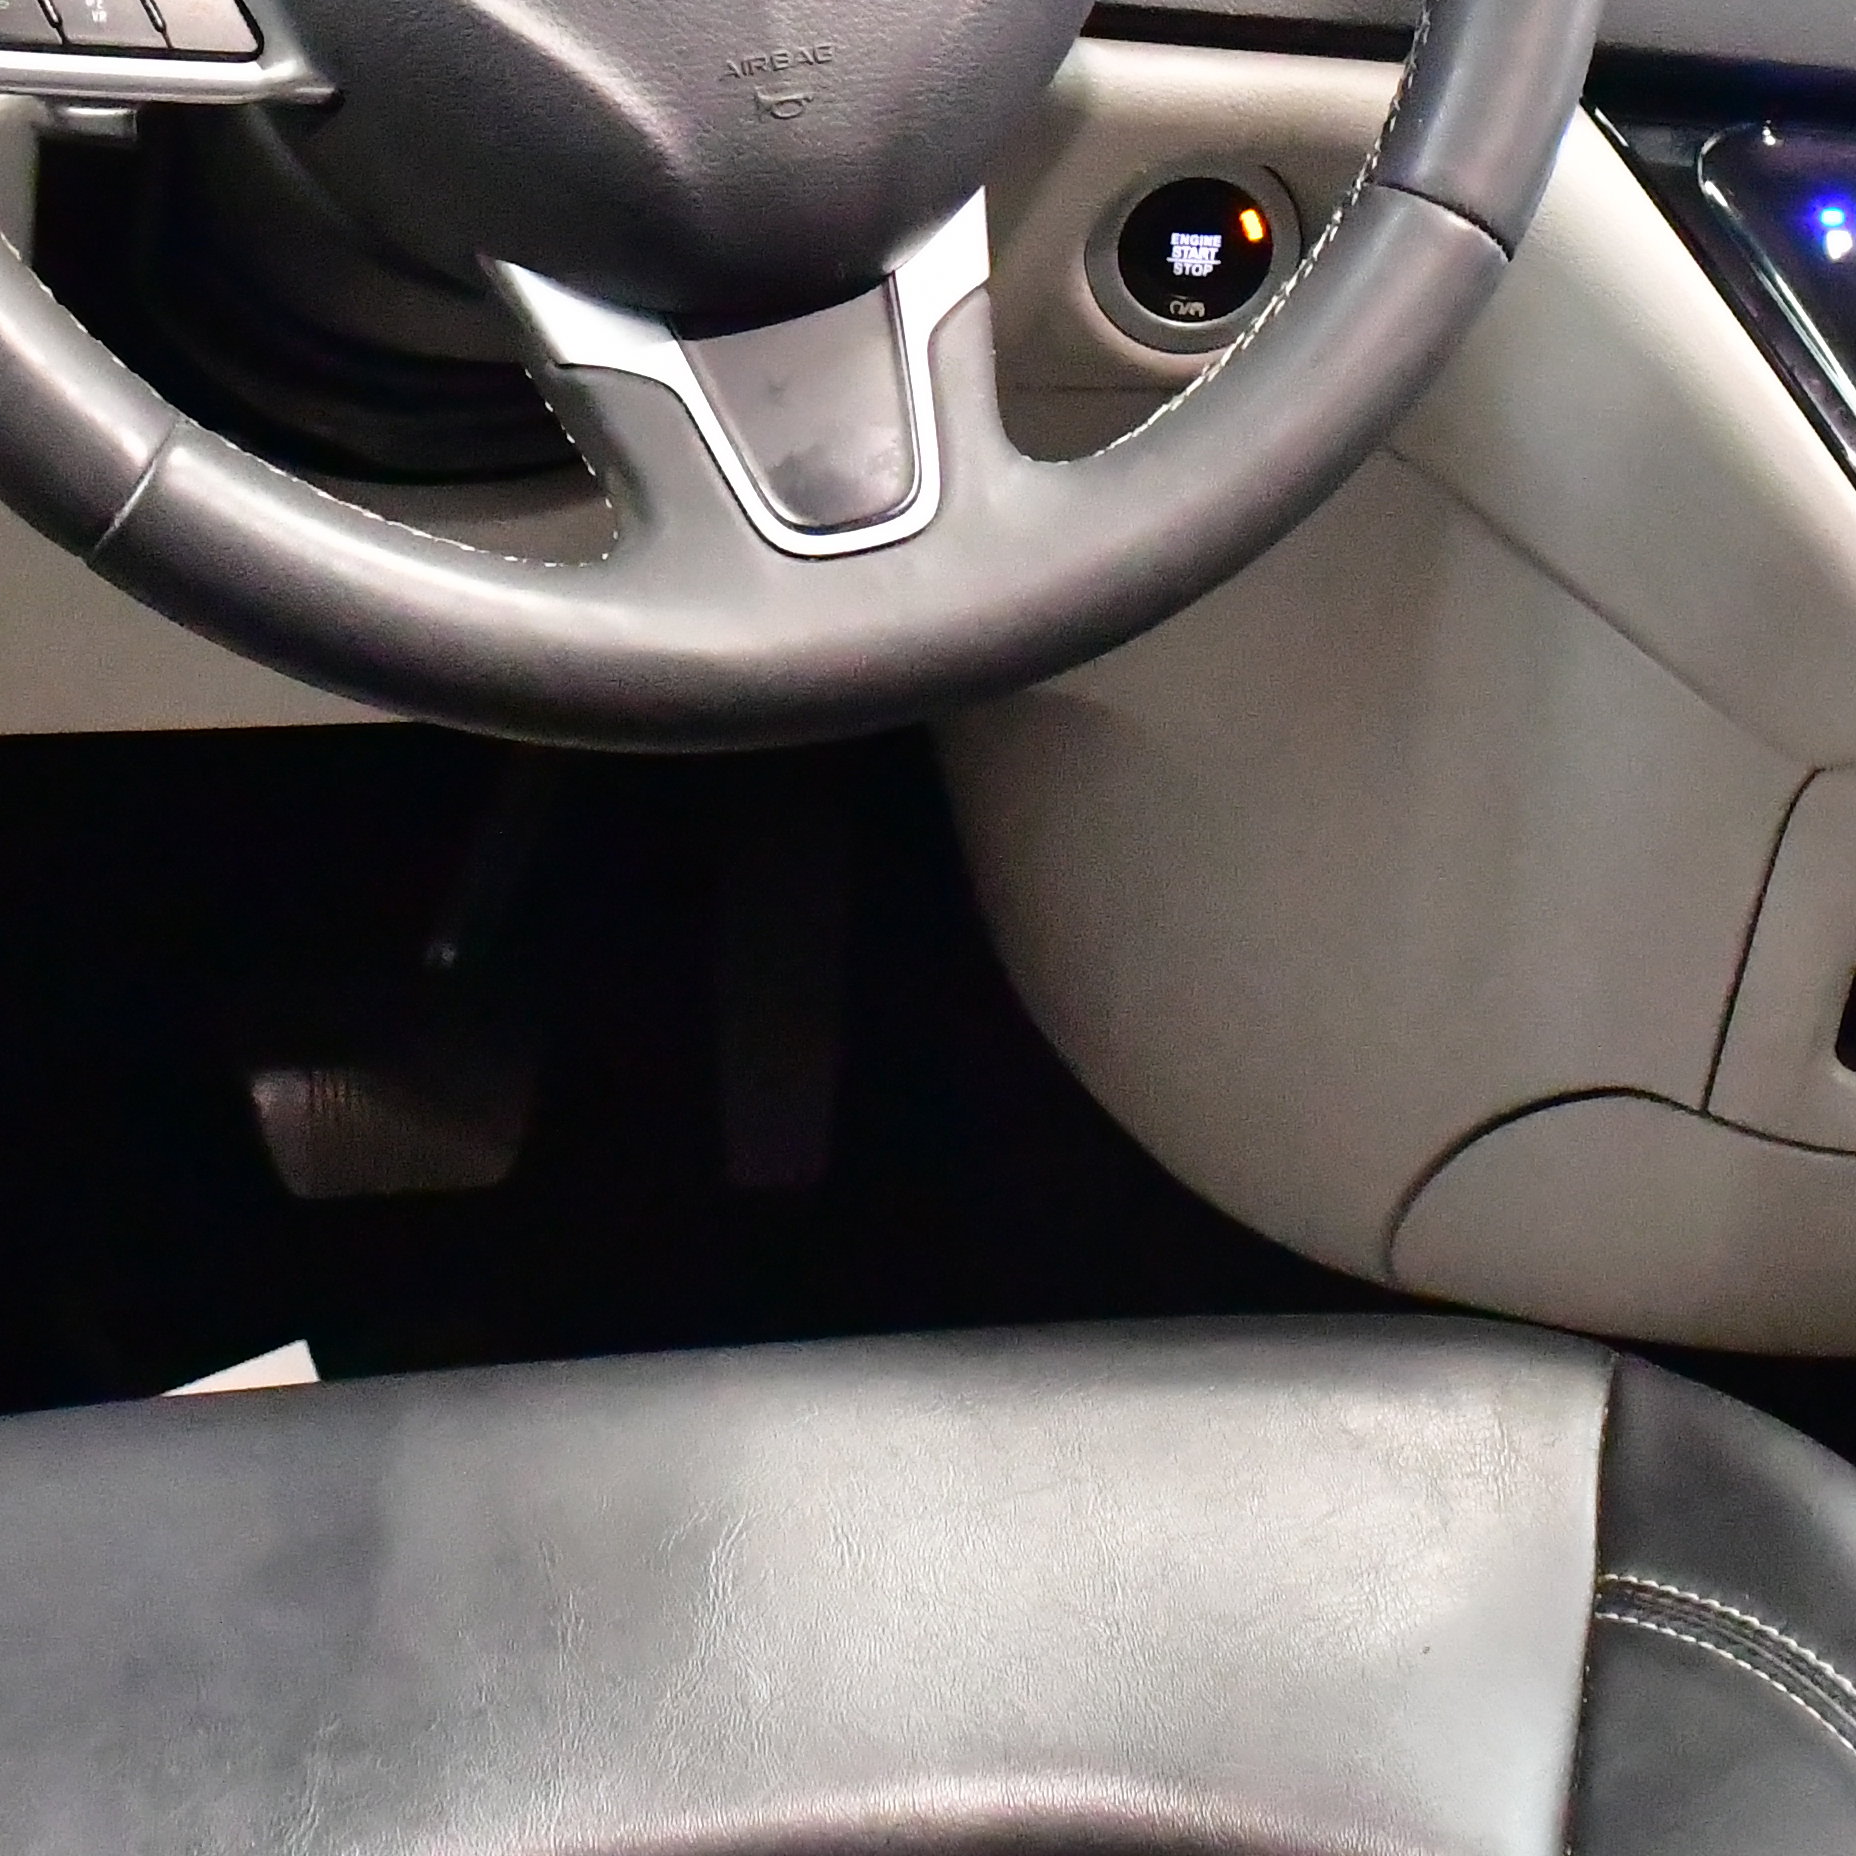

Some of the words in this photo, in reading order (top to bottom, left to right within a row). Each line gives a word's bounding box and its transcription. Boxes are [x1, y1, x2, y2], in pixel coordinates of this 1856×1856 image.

[91, 10, 107, 23] VR
[721, 44, 833, 81] AIRBAG
[1170, 232, 1222, 248] ENGINE
[1826, 229, 1853, 260] P
[1171, 245, 1219, 261] START
[1173, 262, 1214, 277] STOP
